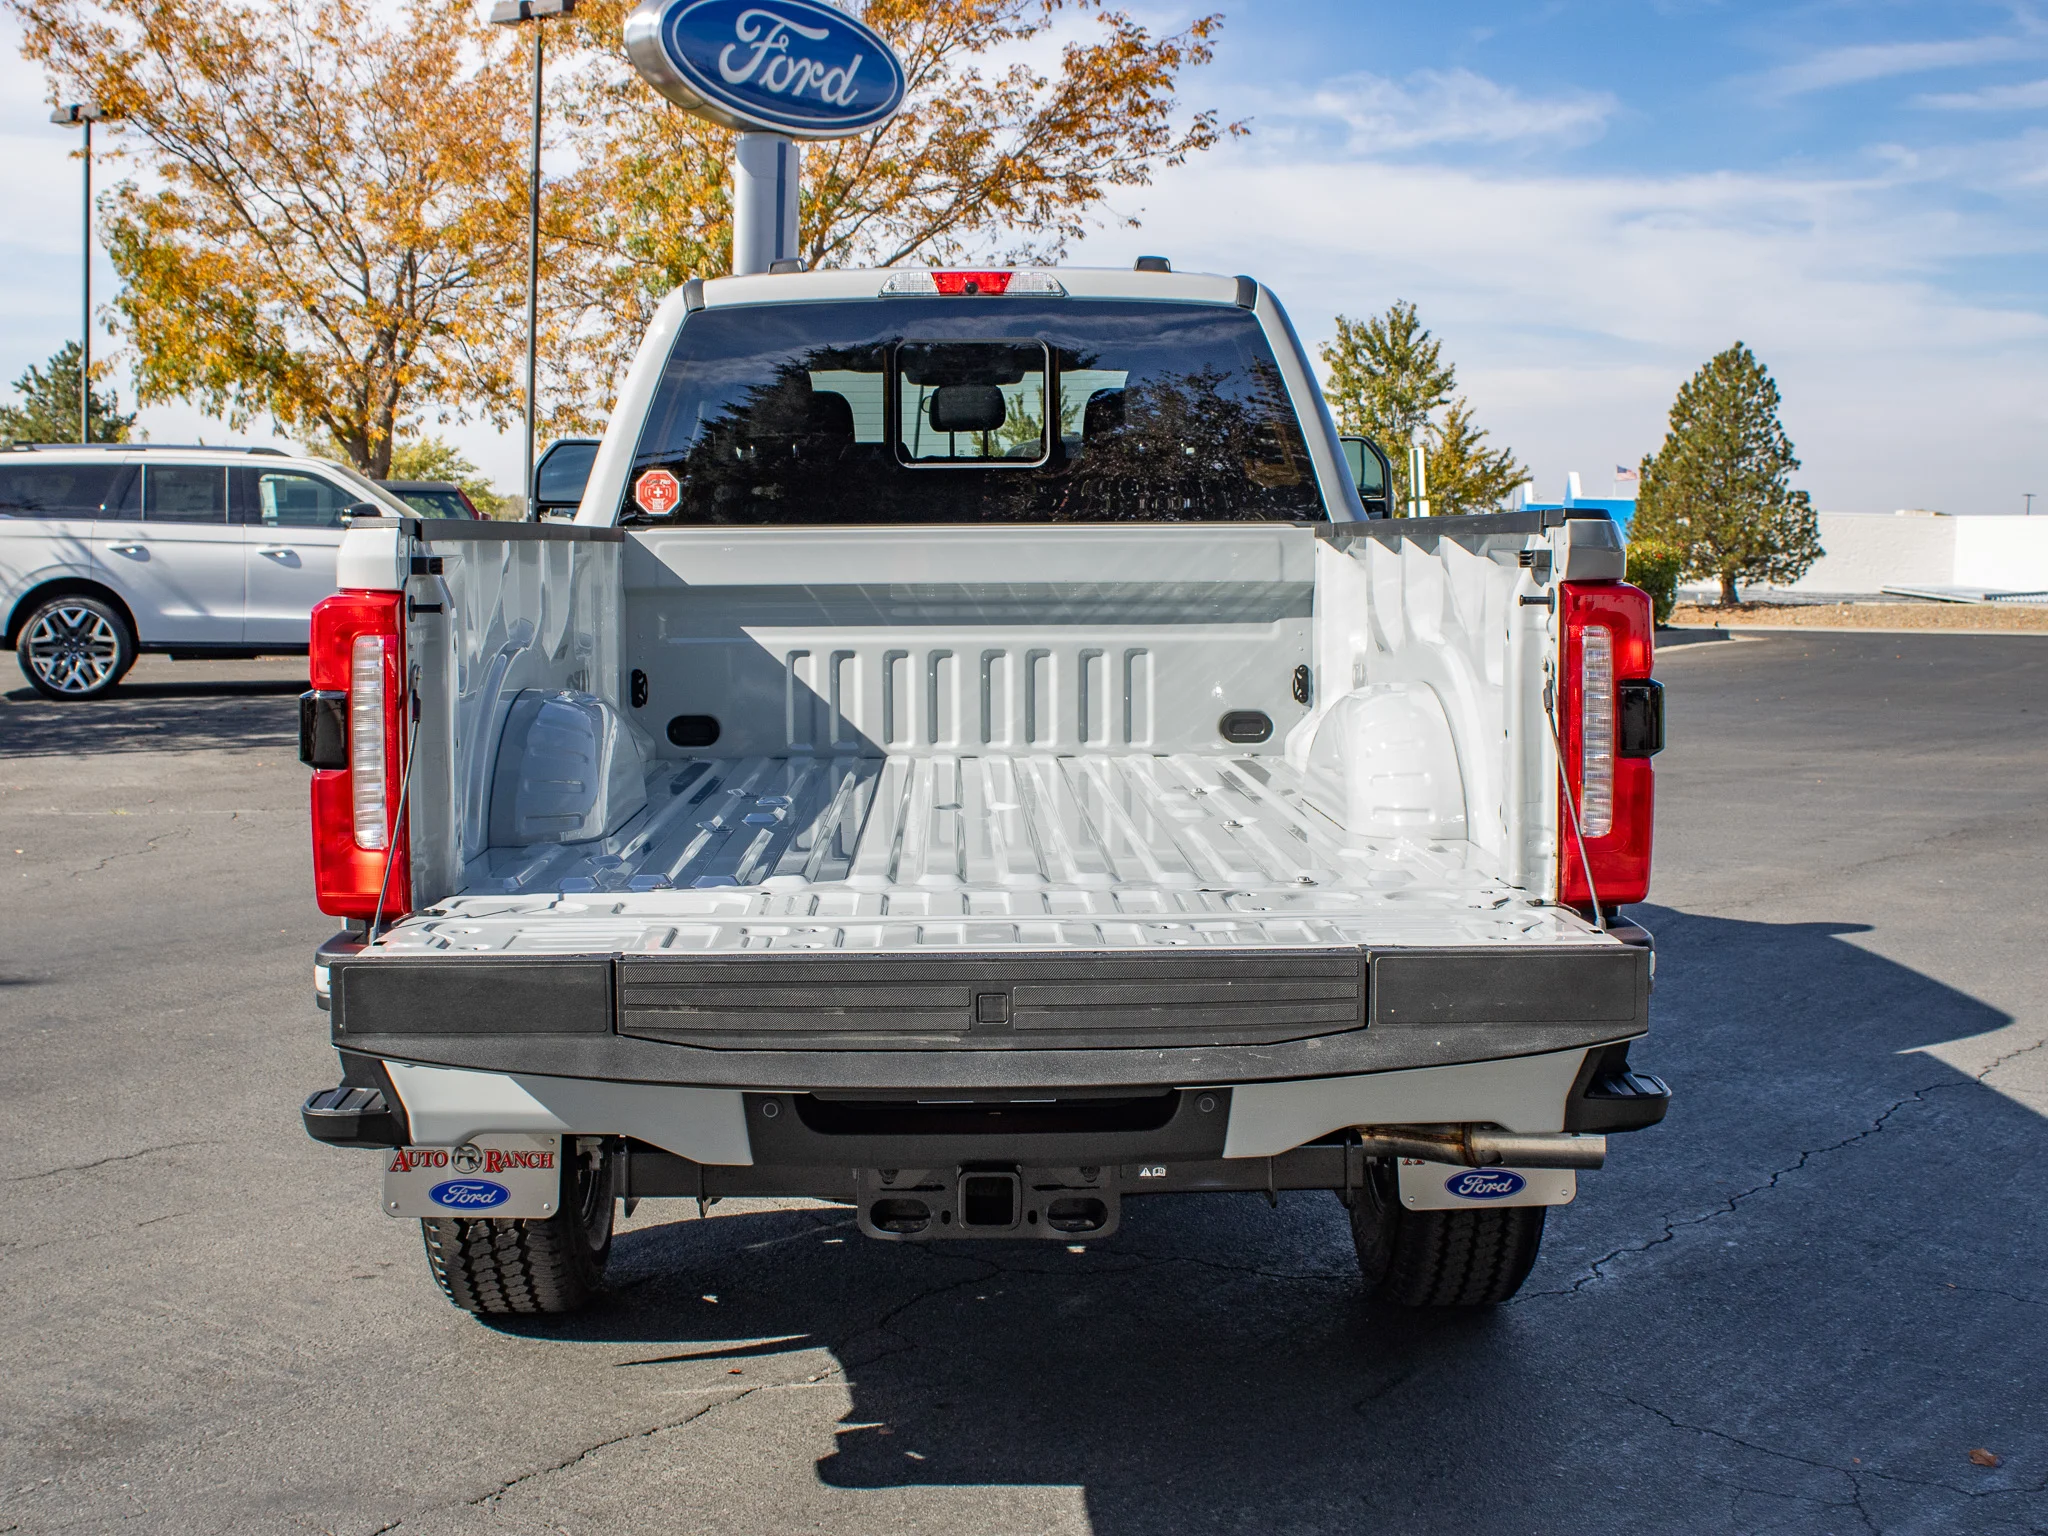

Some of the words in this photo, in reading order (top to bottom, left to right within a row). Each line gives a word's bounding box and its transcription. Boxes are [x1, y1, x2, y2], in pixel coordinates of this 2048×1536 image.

[719, 9, 863, 106] Ford
[389, 1150, 448, 1173] AUTO
[484, 1149, 554, 1174] RANCH
[442, 1184, 497, 1204] Ford
[1458, 1175, 1512, 1194] Ford
